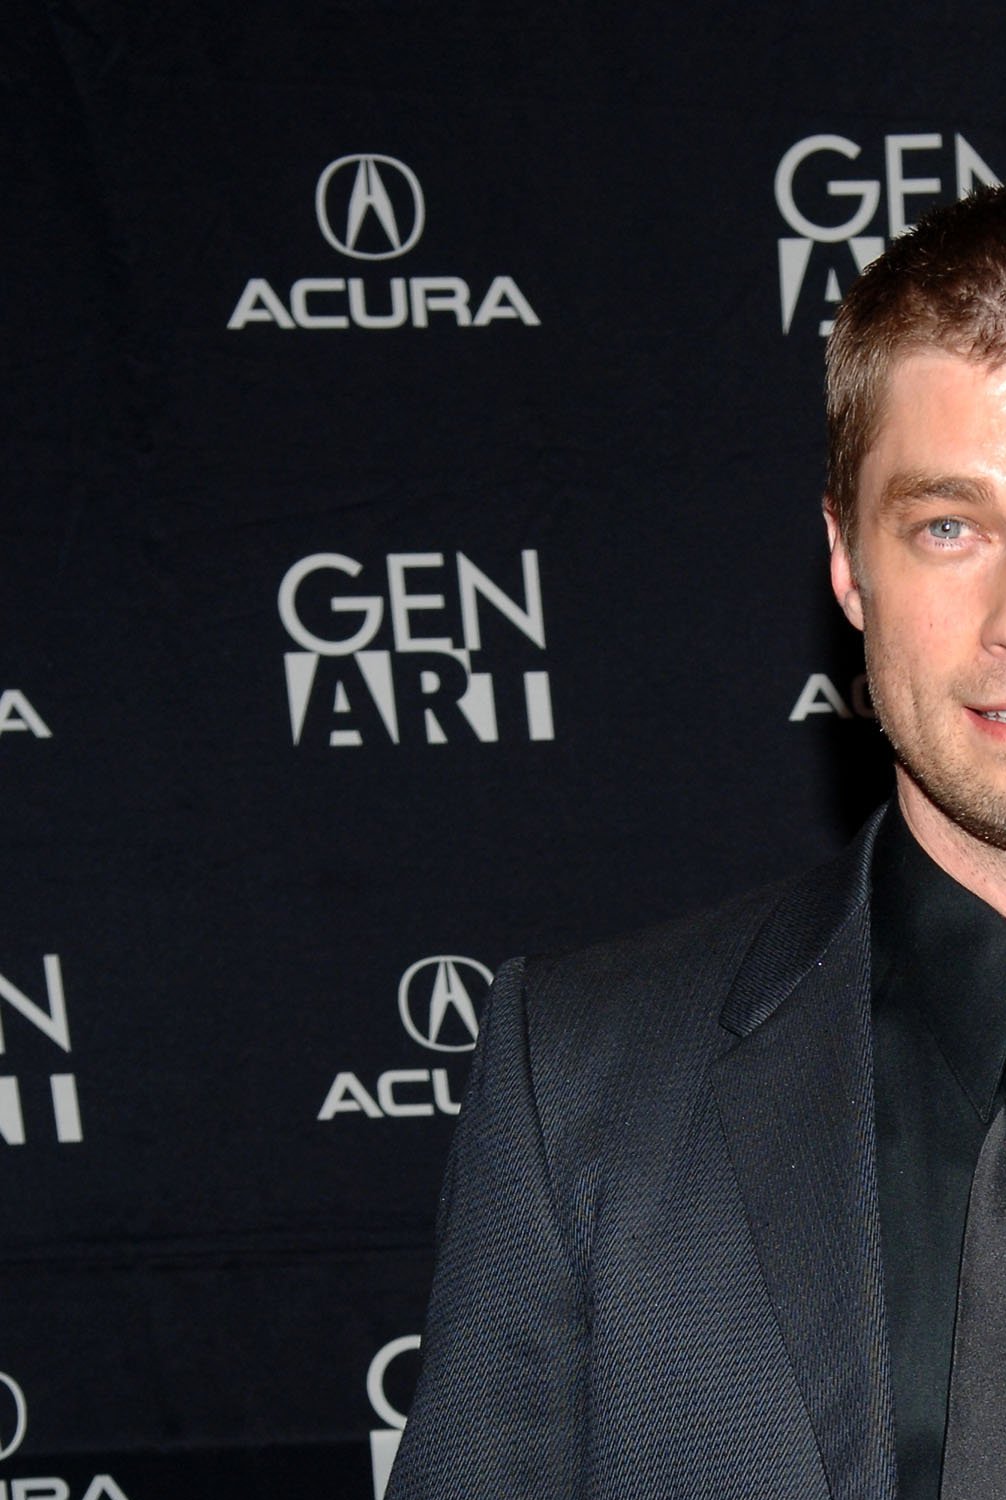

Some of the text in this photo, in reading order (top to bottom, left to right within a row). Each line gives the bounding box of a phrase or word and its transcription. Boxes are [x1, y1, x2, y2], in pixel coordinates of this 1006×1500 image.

[227, 277, 540, 329] ACURA
[277, 549, 546, 656] GEN
[284, 648, 555, 747] ART
